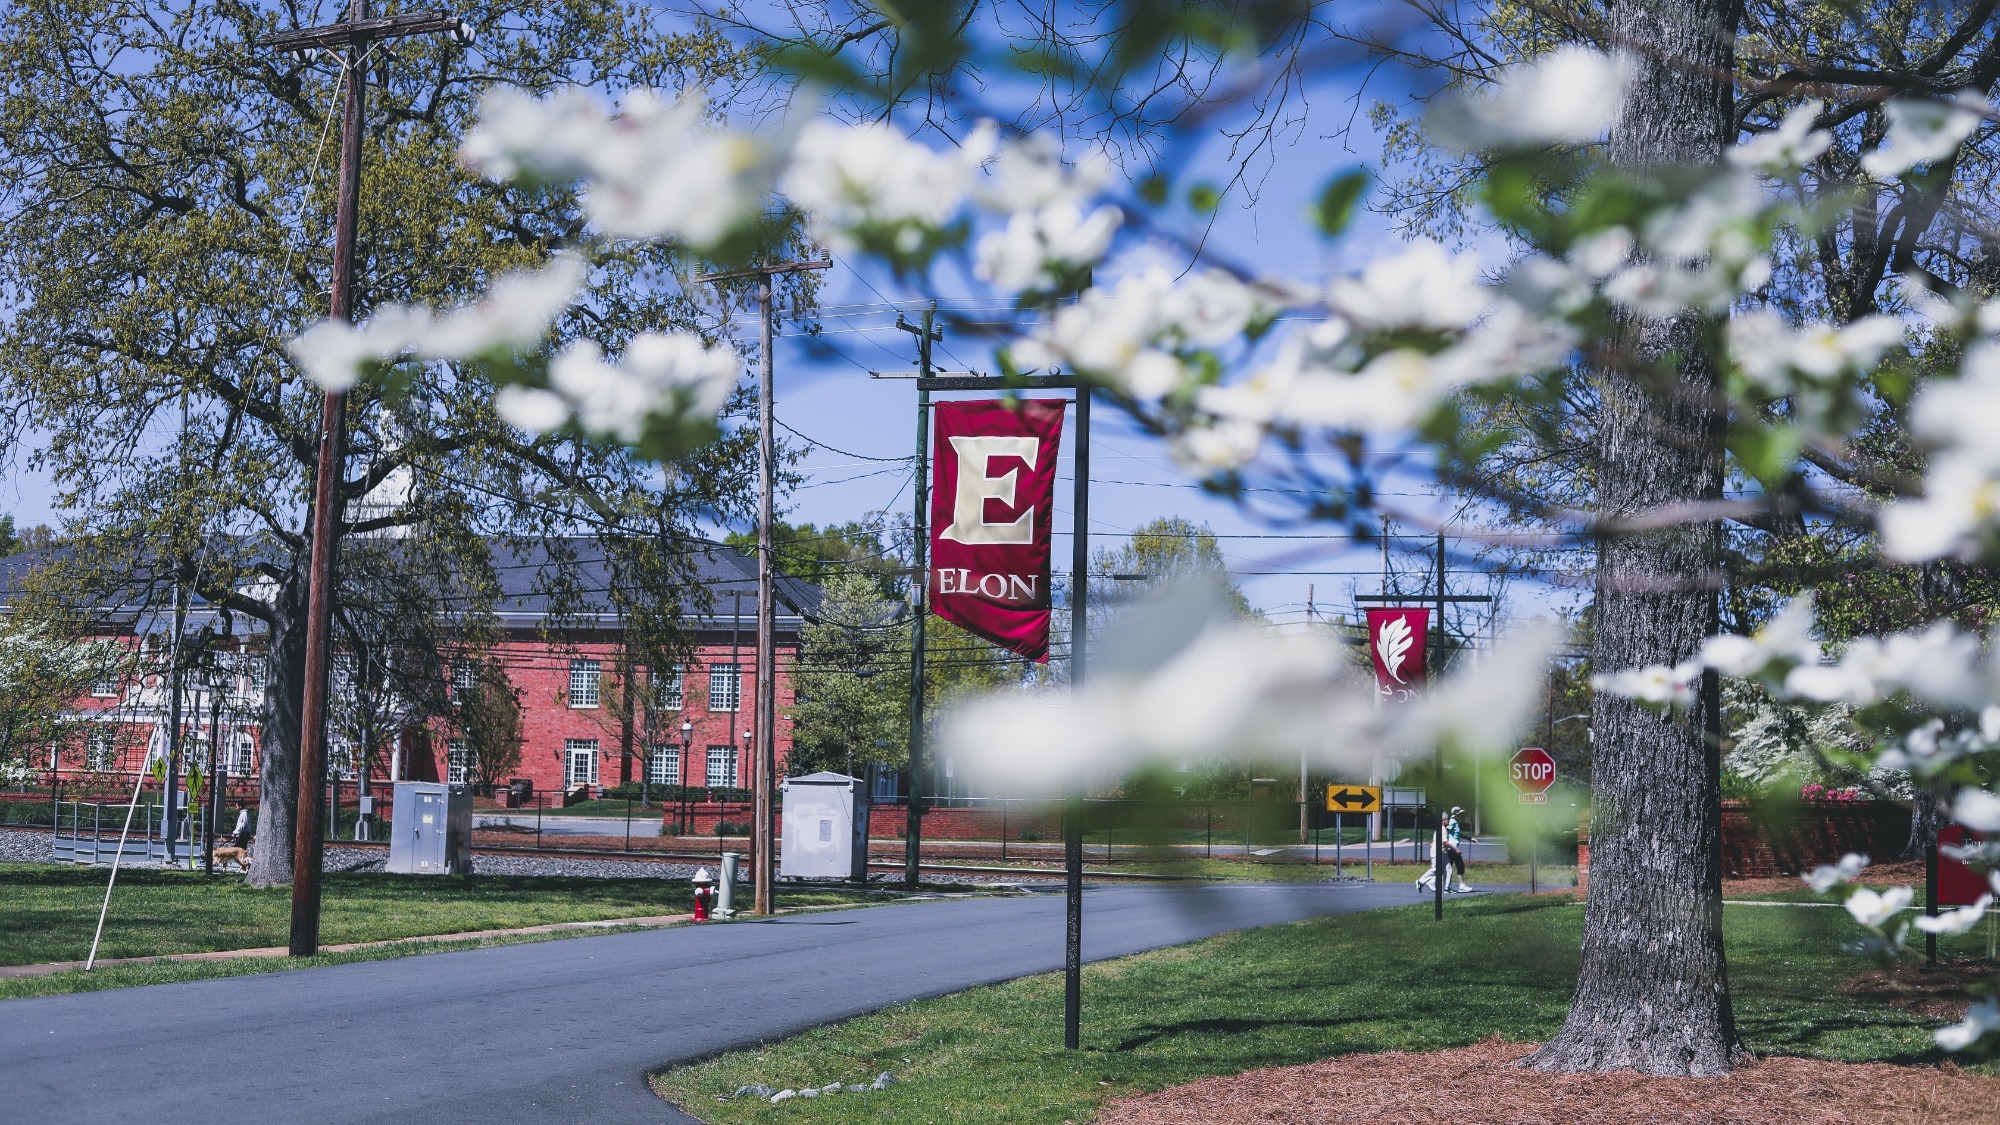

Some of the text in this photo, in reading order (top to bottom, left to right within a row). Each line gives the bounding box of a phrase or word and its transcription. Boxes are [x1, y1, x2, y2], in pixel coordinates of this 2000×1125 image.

[939, 436, 1040, 545] E
[938, 568, 1039, 600] ELON
[1512, 763, 1552, 780] STOP
